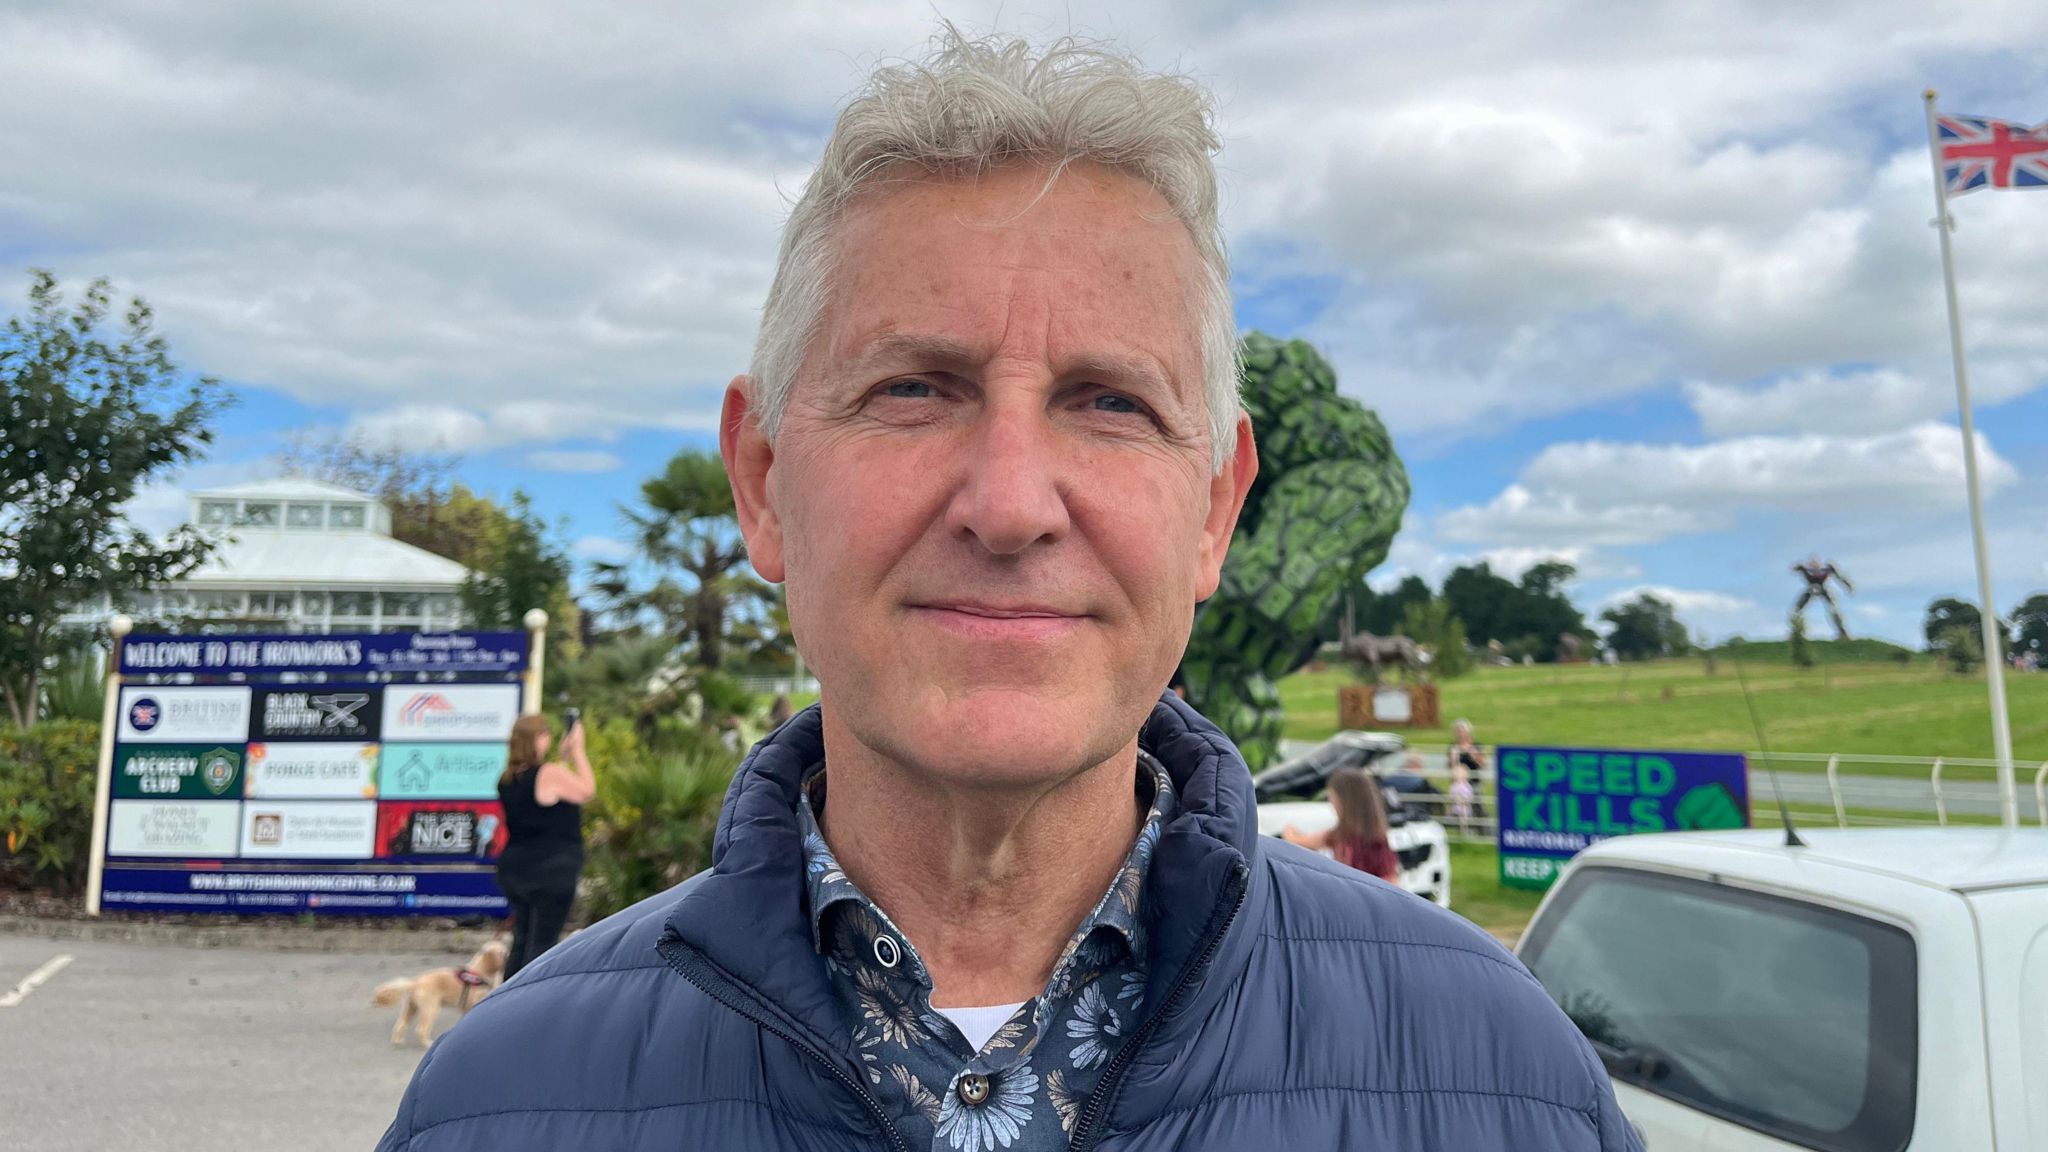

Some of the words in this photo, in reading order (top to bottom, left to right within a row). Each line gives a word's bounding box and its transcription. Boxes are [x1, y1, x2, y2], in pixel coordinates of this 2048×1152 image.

[125, 642, 202, 667] WELCOME
[204, 642, 227, 667] TO
[229, 641, 260, 666] THE
[265, 693, 308, 709] BLACK
[264, 708, 323, 728] COUNTRY
[125, 757, 198, 776] ARCHERY
[1501, 751, 1676, 797] SPEED
[139, 775, 181, 793] CLUB
[1513, 793, 1666, 833] KILLS
[412, 822, 473, 848] NICE
[1503, 829, 1587, 849] NATIONAL
[1503, 858, 1551, 879] KEEP
